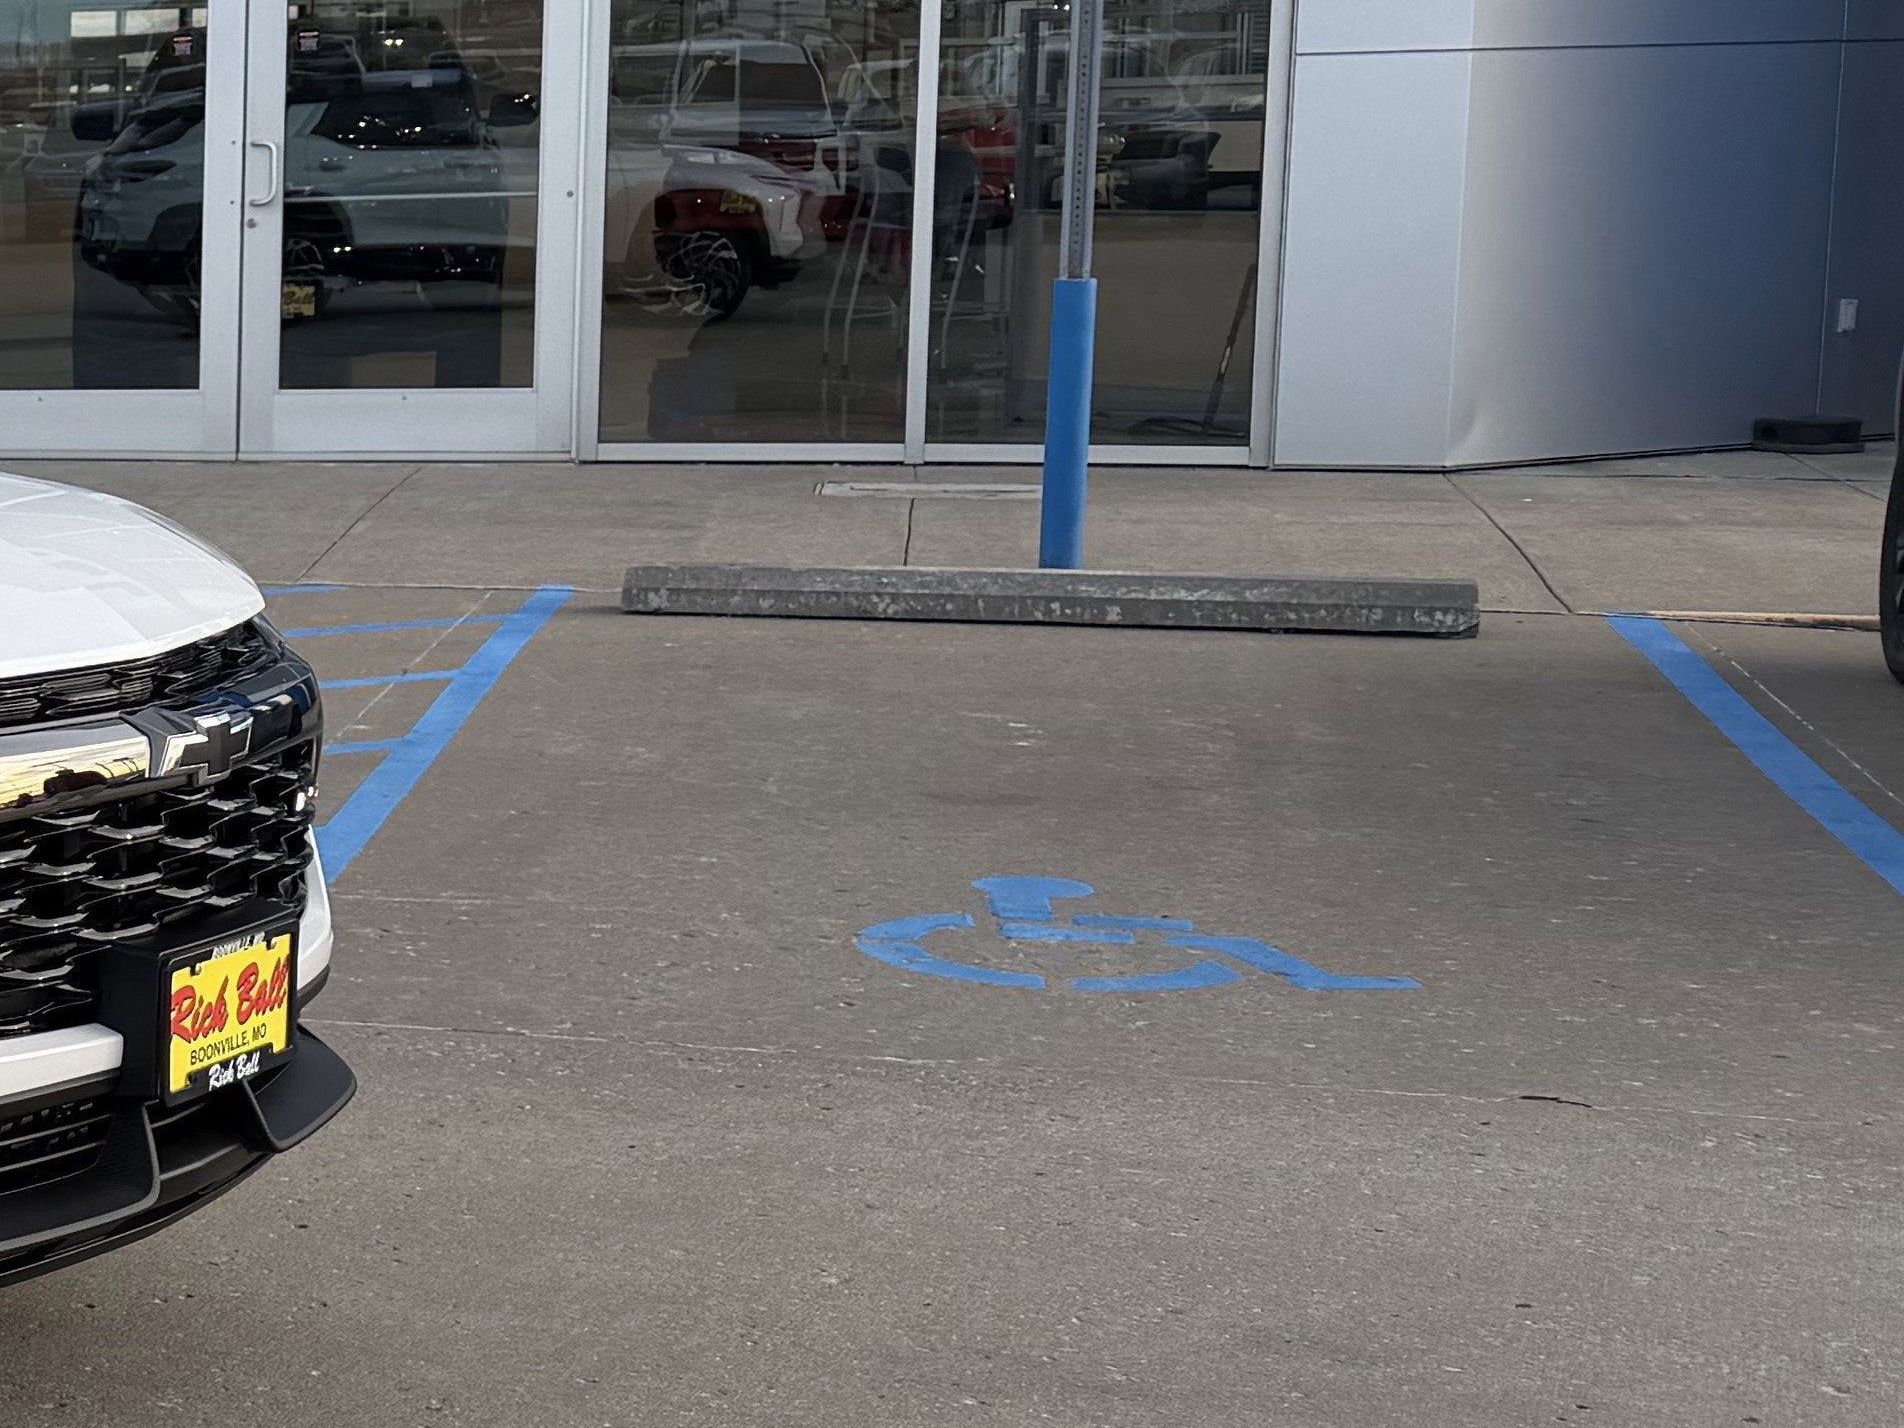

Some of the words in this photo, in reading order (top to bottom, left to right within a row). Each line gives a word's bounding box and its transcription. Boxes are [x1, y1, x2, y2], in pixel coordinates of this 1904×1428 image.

[171, 974, 230, 1044] Rick
[235, 953, 290, 1025] Ball
[190, 1031, 250, 1066] BOONVILLE,
[252, 1022, 268, 1043] MO
[208, 1060, 235, 1092] Rick
[236, 1051, 261, 1081] Ball
